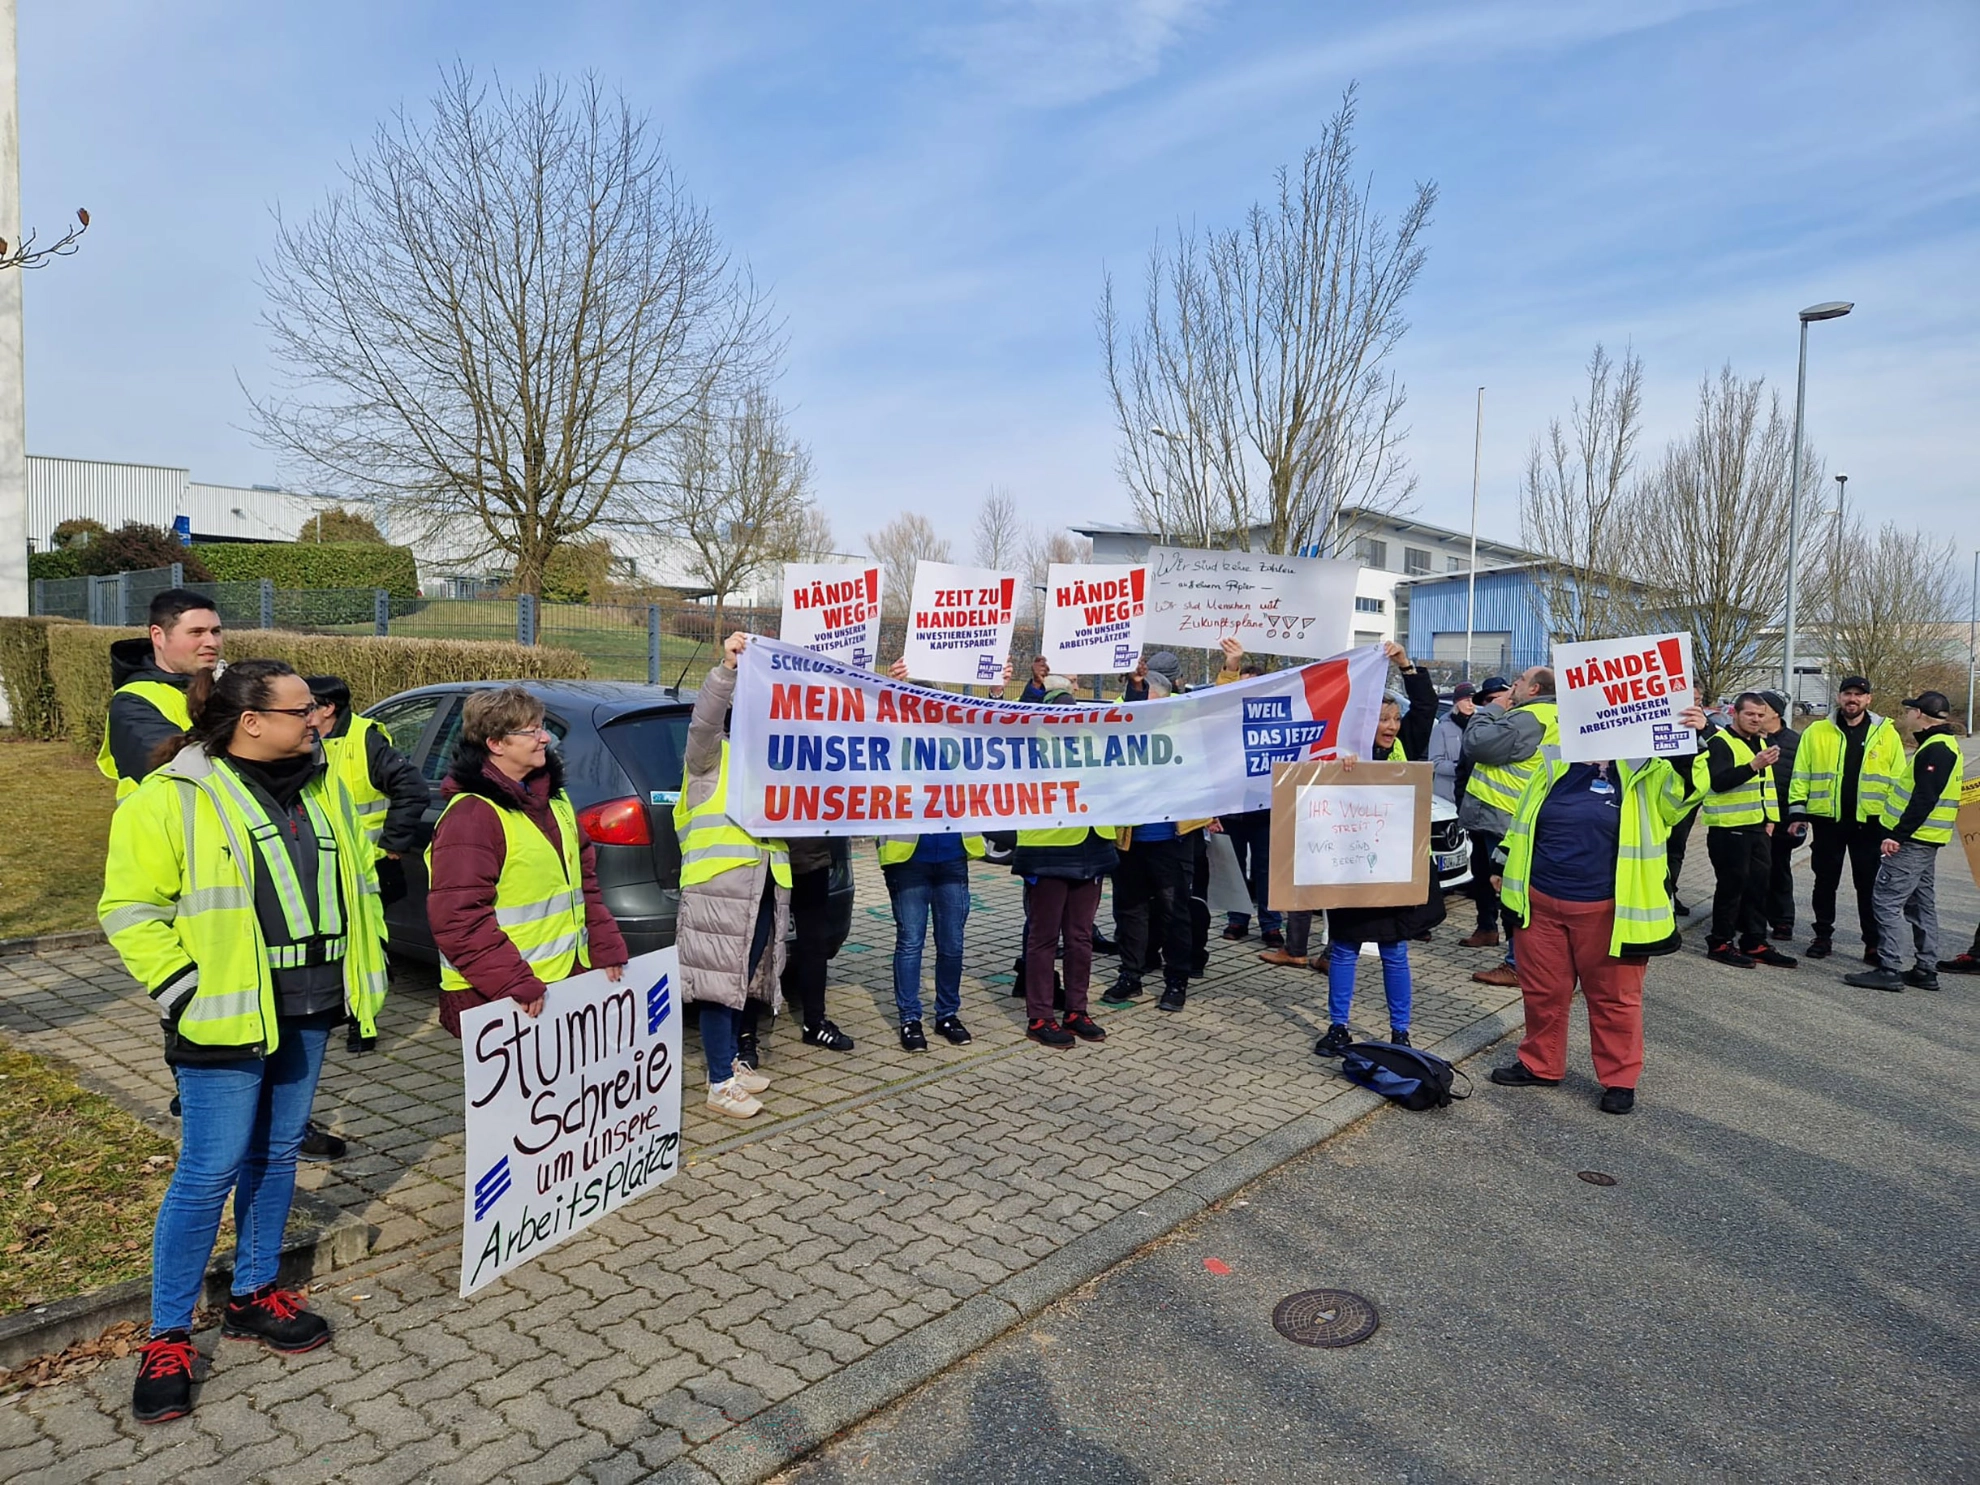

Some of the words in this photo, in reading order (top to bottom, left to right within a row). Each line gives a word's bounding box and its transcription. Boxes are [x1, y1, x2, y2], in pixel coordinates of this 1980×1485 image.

[1222, 558, 1253, 572] keine
[793, 577, 864, 610] HÄNDE
[935, 589, 973, 607] ZEIT
[1056, 578, 1129, 608] HÄNDE
[1226, 579, 1255, 594] Papier
[1155, 600, 1177, 612] Wir
[1207, 599, 1251, 611] Menschen
[1259, 598, 1281, 610] mit
[814, 631, 833, 642] VON
[834, 623, 866, 639] UNSEREN
[916, 630, 972, 641] INVESTIEREN
[974, 628, 997, 638] STATT
[1059, 631, 1131, 650] ARBEITSPLÄTZEN!
[1075, 628, 1093, 638] VON
[1094, 621, 1130, 634] UNSEREN
[930, 638, 997, 650] KAPUTTSPAREN!
[1565, 649, 1661, 690] HÄNDE
[771, 654, 845, 674] SCHLUSS
[849, 672, 884, 684] MIT
[885, 683, 995, 708] ABWICKLUNG
[999, 703, 1032, 711] UND
[769, 682, 865, 722] MEIN
[1246, 702, 1286, 719] WEIL
[1596, 708, 1618, 720] VON
[1621, 697, 1669, 714] UNSEREN
[1580, 708, 1672, 735] ARBEITSPLÄTZEN!
[1247, 728, 1282, 746] DAS
[1284, 725, 1325, 748] JETZT
[768, 734, 891, 772] UNSER
[901, 733, 1183, 771] INDUSTRIELAND.
[764, 784, 913, 821] UNSERE
[923, 780, 1089, 819] ZUKUNFT.
[1308, 799, 1332, 818] IHR
[1340, 800, 1395, 819] WOLLT
[514, 1041, 672, 1155] Schreie
[536, 1148, 574, 1196] um
[582, 1104, 661, 1173] unsere
[470, 1131, 679, 1287] Arbeitsplätze
